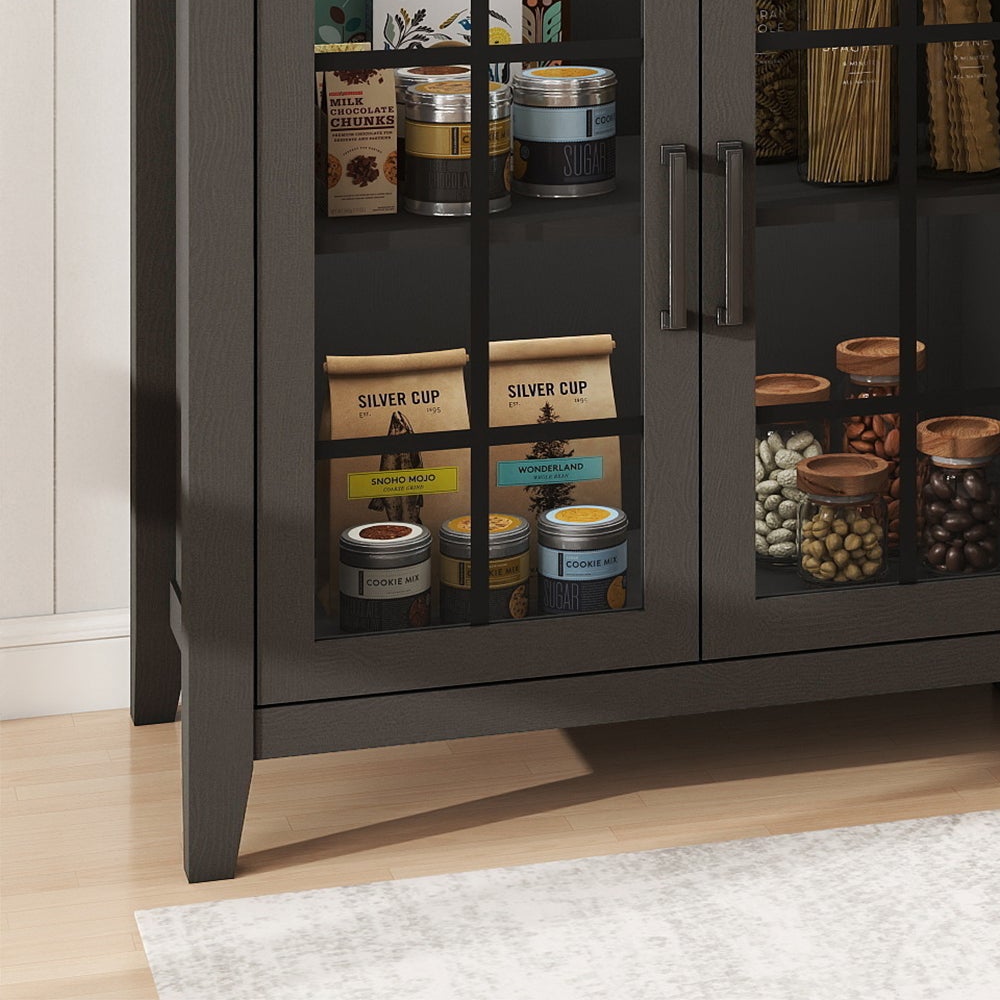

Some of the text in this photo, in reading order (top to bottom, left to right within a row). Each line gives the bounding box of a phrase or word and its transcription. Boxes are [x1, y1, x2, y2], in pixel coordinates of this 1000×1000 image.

[330, 97, 364, 107] MILK
[330, 106, 395, 116] CHOCOLATE
[330, 115, 395, 128] CHUNKS
[563, 143, 606, 177] SUGAR
[508, 380, 588, 398] SILVER CUP
[358, 389, 440, 408] SILVER CUP
[518, 462, 584, 474] WONDERLAND
[371, 474, 436, 486] SNOHO MOJO
[565, 555, 618, 569] COOKIE MIX
[366, 574, 420, 587] COOKIE MIX
